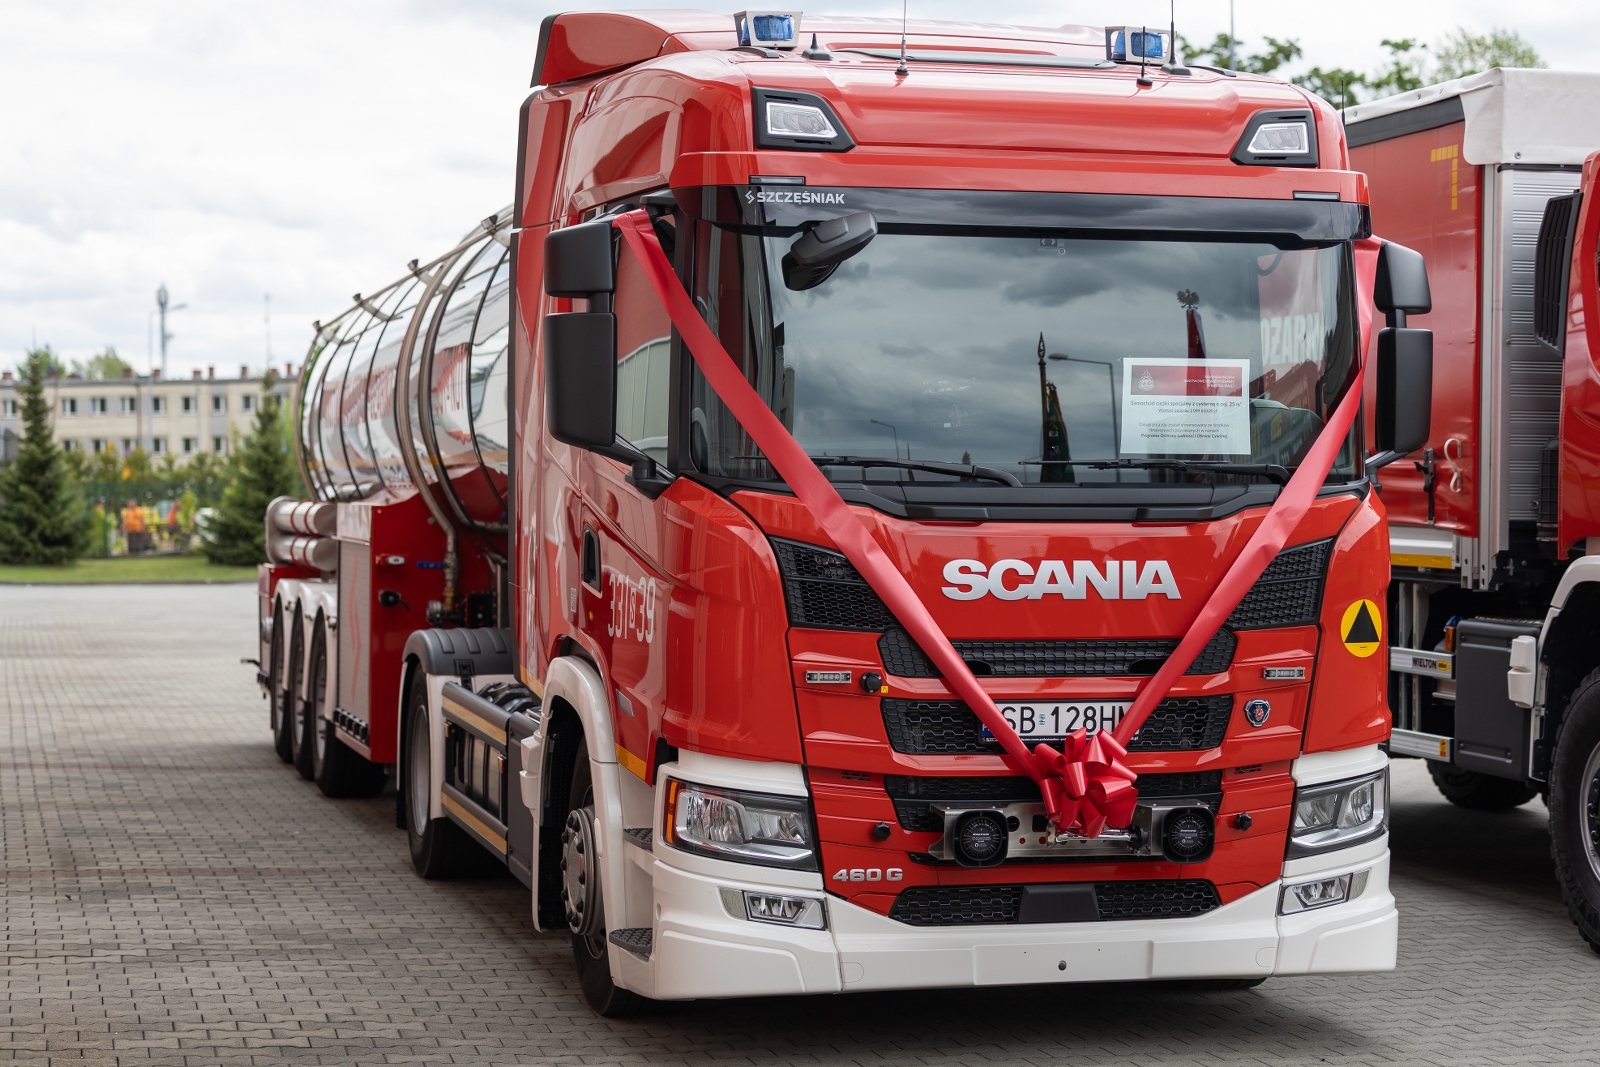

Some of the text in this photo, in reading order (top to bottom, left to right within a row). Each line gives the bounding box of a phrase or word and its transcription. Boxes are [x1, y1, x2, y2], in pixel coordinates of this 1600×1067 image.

[756, 190, 845, 204] SZCZĘŚNIAK
[941, 558, 1182, 601] SCANIA
[1412, 656, 1438, 670] WIELTON
[1001, 706, 1036, 734] SB
[832, 868, 903, 882] 460 G
